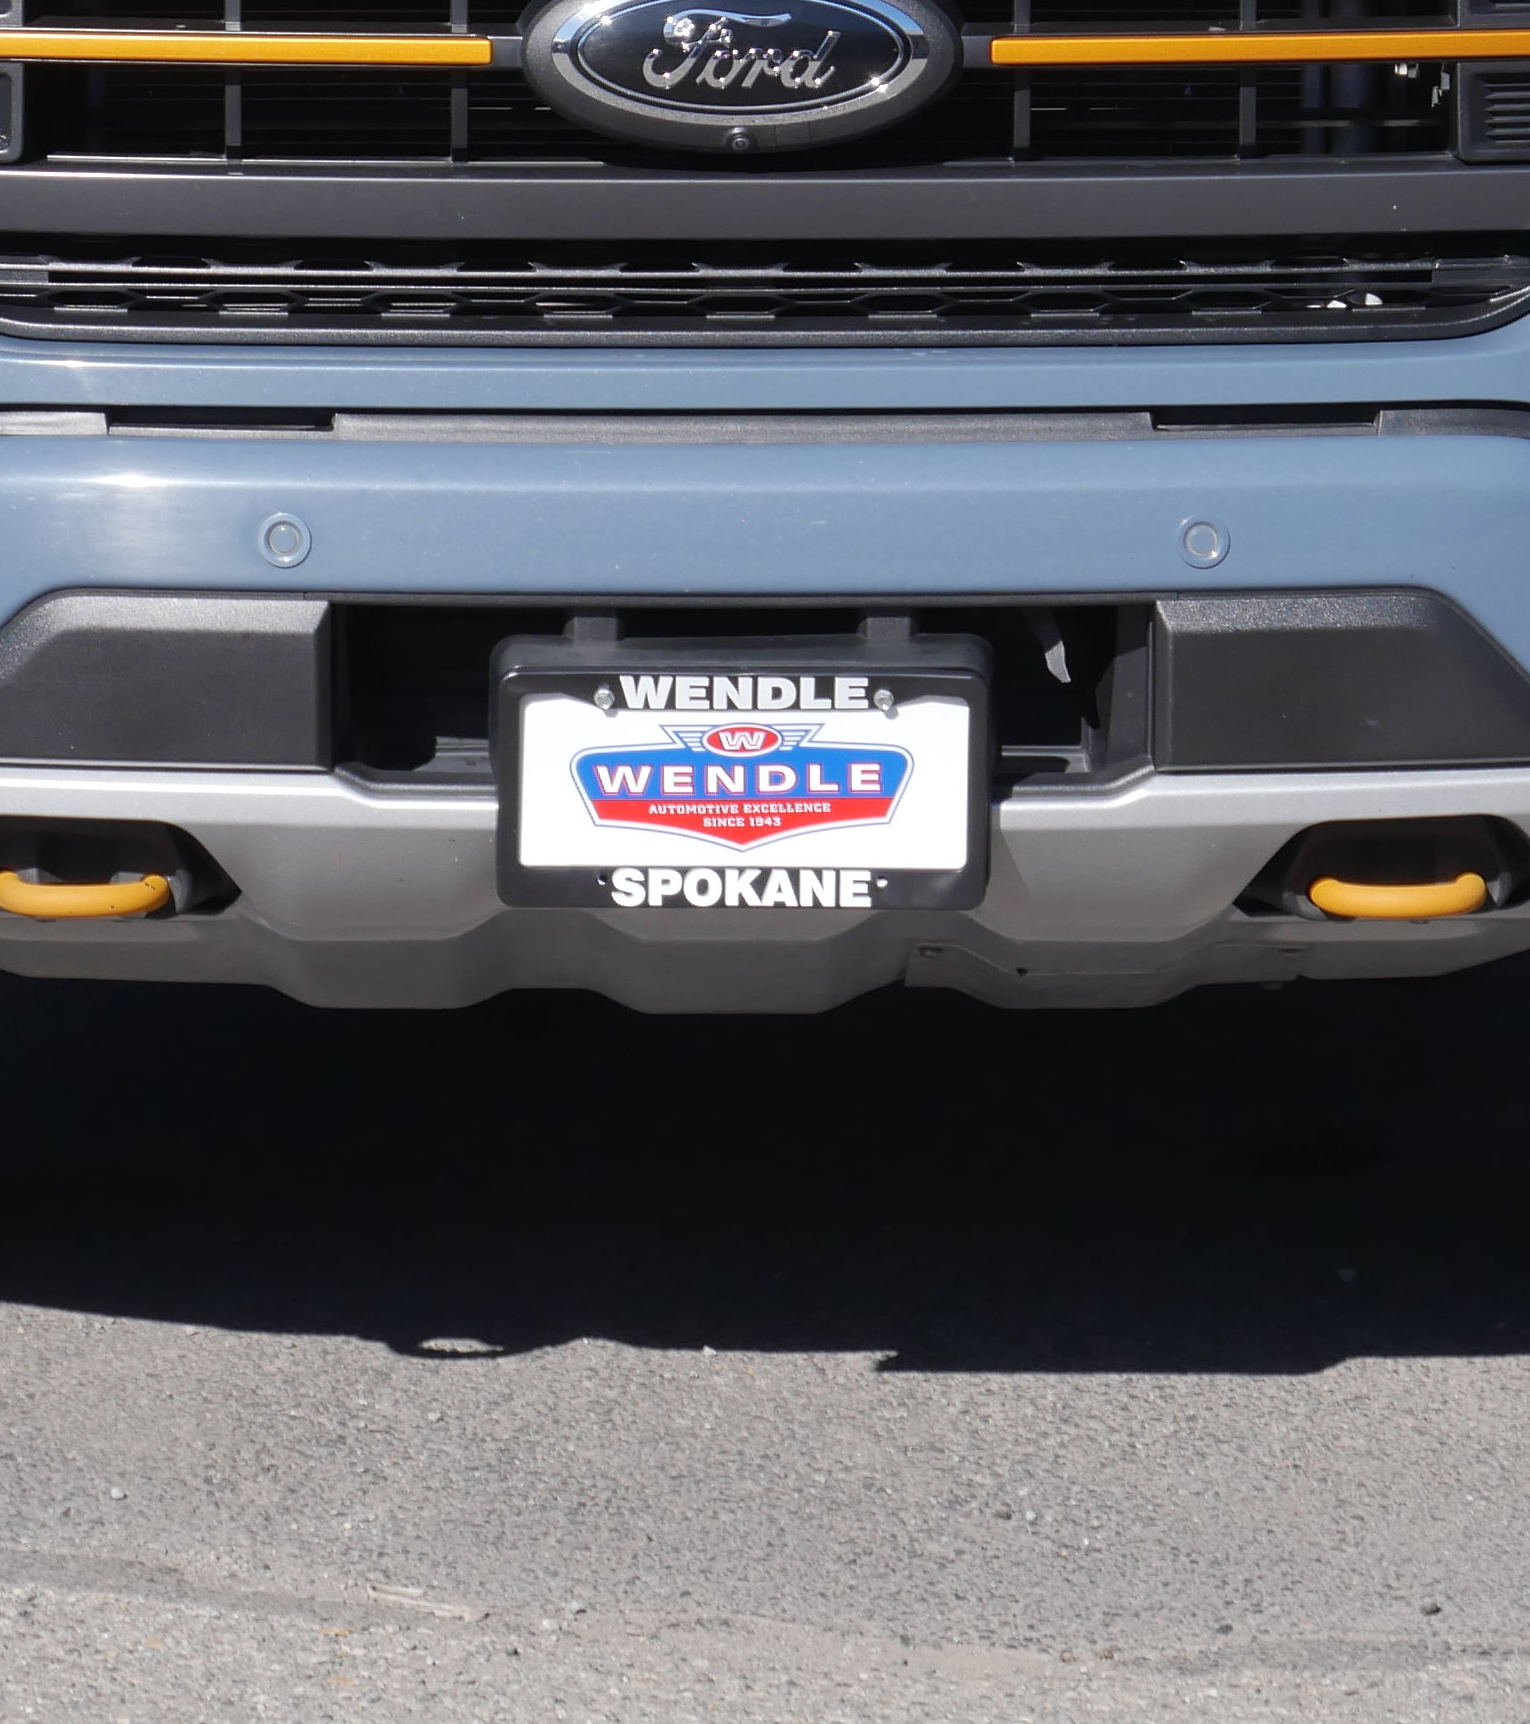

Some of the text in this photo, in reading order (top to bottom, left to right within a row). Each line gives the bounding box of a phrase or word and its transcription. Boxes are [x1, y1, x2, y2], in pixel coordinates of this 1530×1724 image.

[643, 8, 841, 89] Ford
[619, 675, 869, 710] WENDLE
[719, 732, 767, 751] W
[595, 762, 882, 795] WENDLE
[648, 802, 832, 815] AUTOMOTIVE EXCELLENCE
[703, 817, 781, 828] SINCE 1943
[611, 867, 873, 908] SPOKANE
